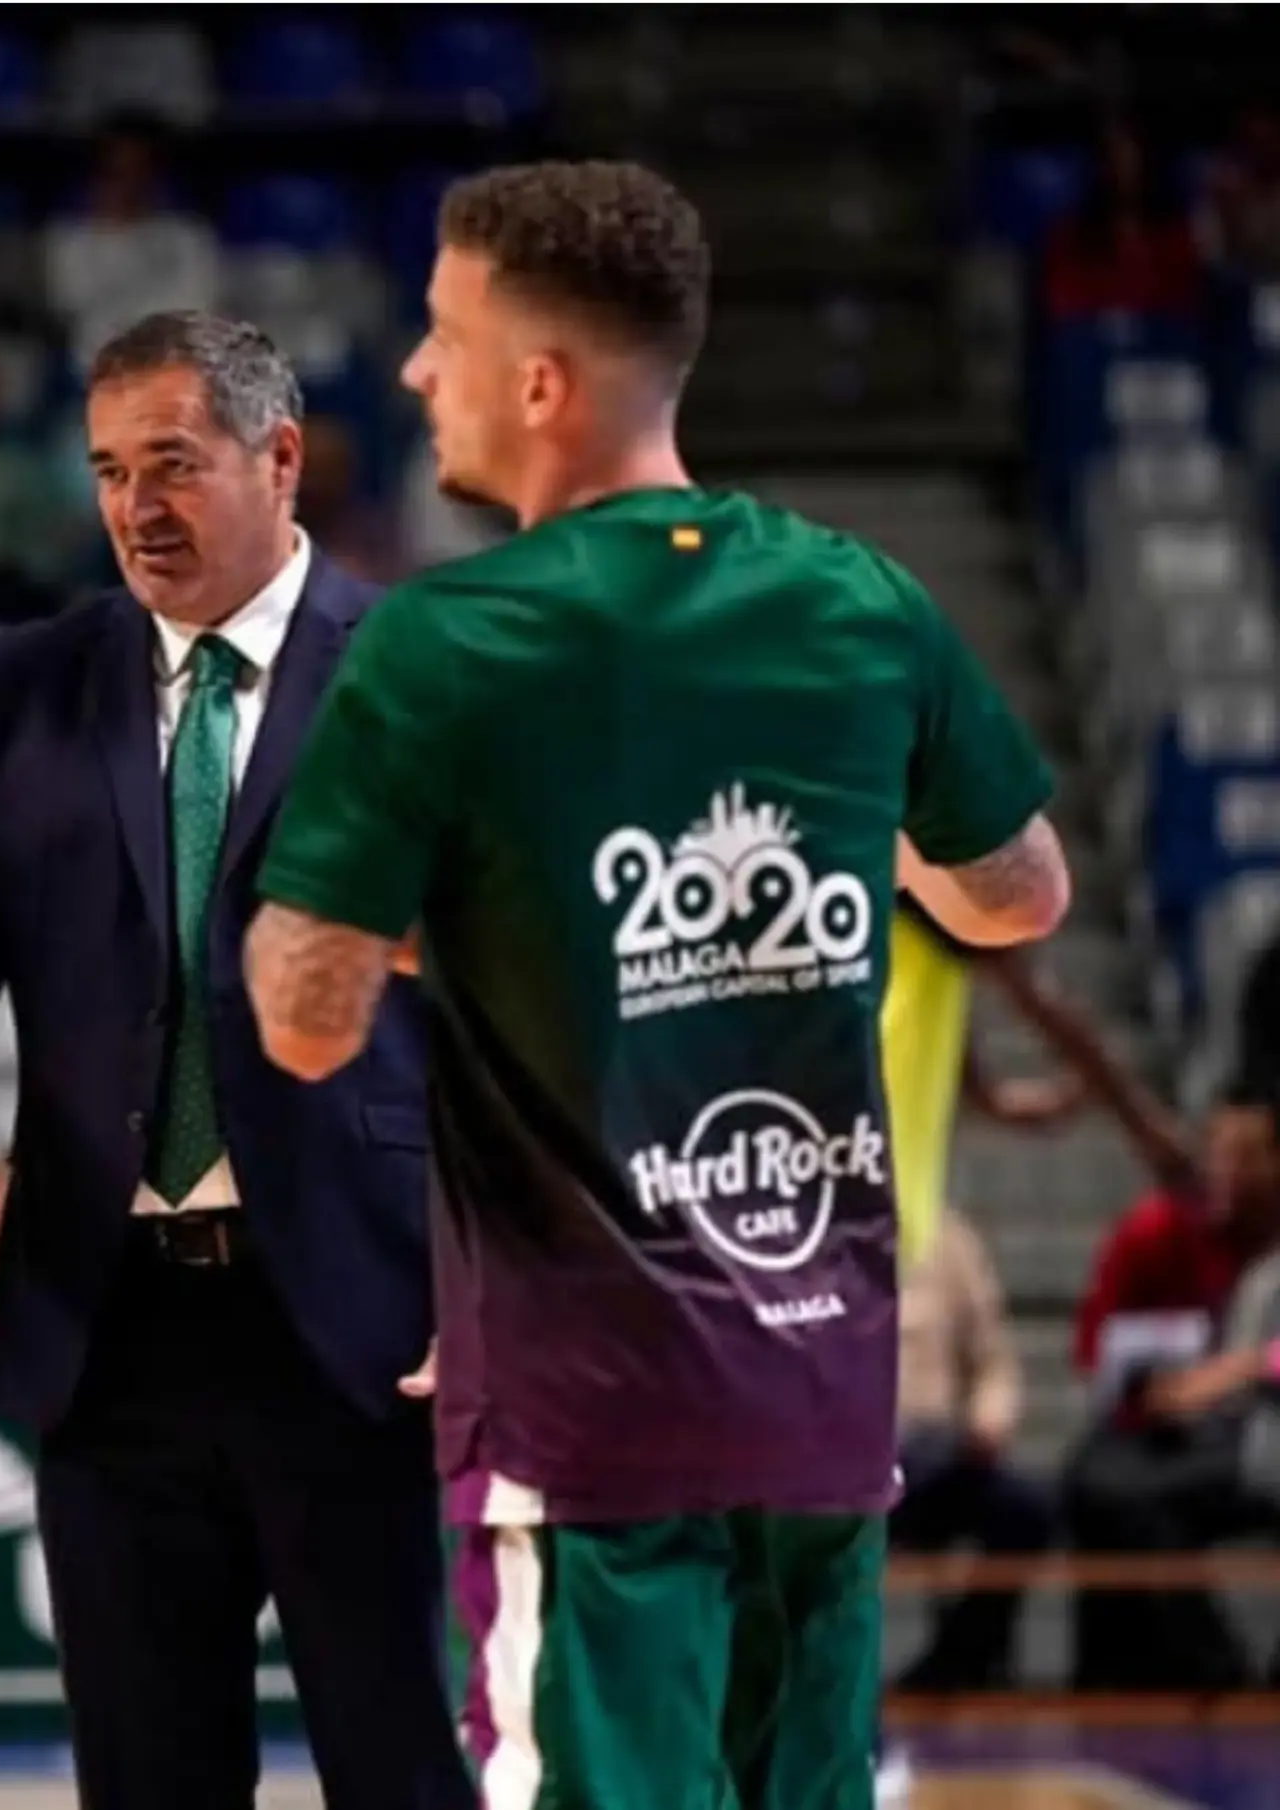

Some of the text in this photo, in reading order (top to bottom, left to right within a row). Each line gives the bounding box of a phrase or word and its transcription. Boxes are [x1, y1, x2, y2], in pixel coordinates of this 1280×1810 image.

[593, 826, 872, 969] 2020
[629, 1112, 886, 1214] Hard Rock
